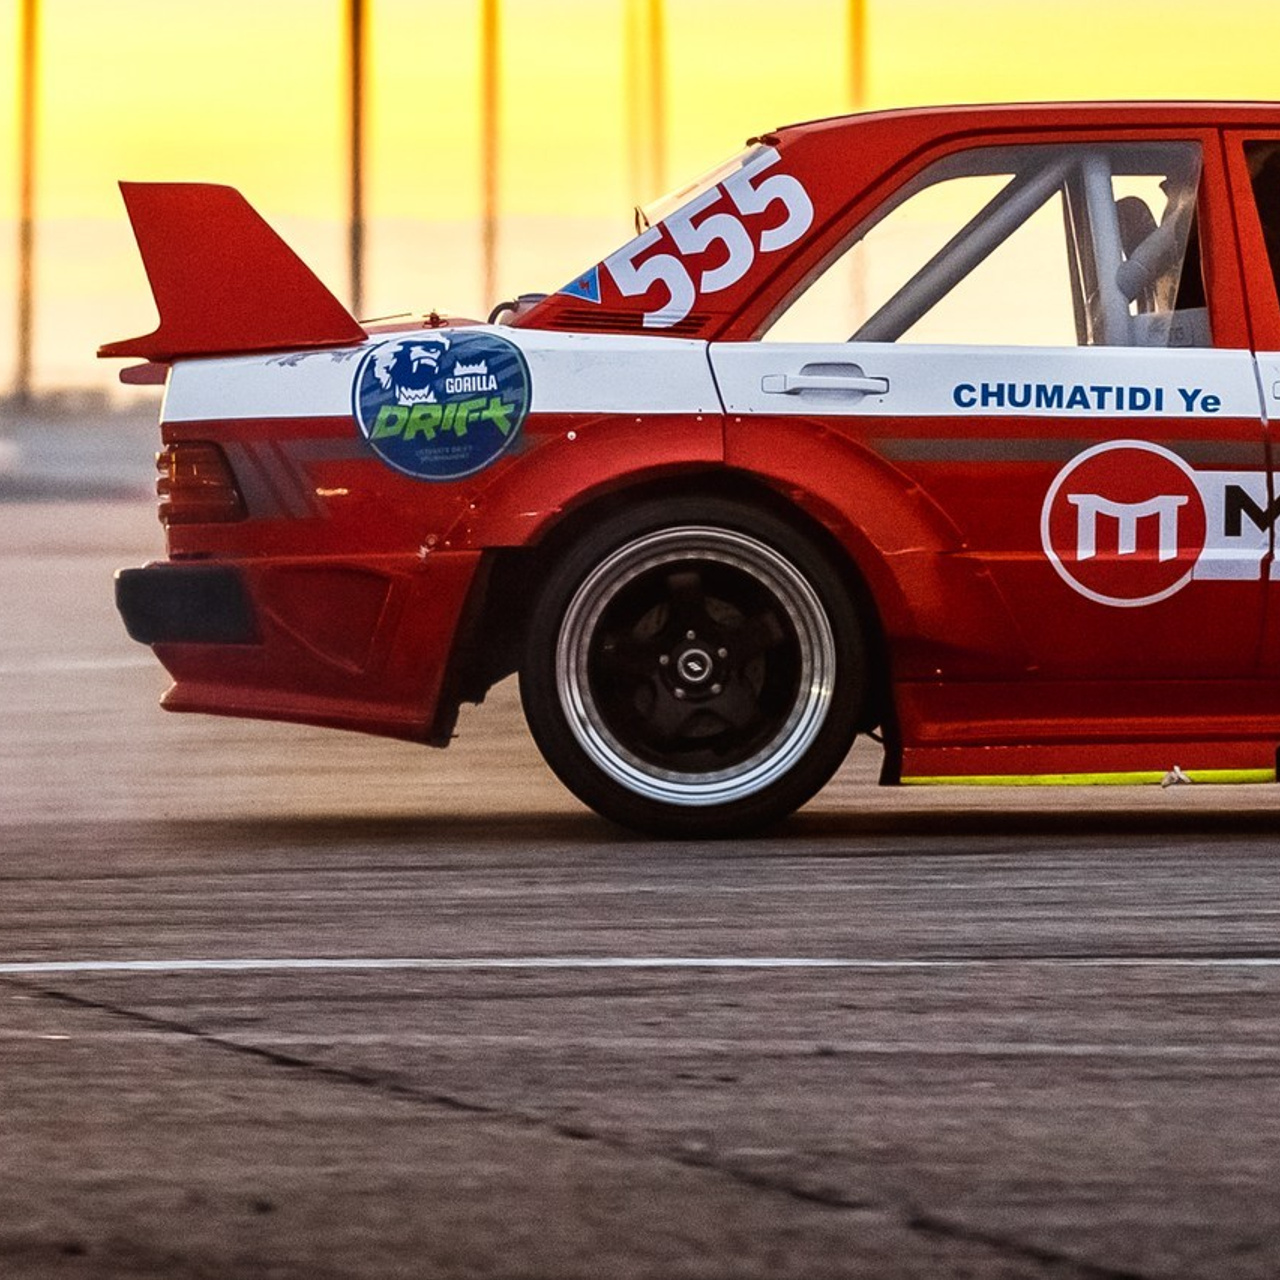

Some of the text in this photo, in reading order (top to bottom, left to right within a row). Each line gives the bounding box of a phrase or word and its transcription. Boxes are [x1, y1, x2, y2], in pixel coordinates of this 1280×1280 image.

[602, 146, 815, 329] 555
[445, 374, 498, 394] GORILLA
[952, 382, 1222, 413] CHUMATIDI Ye
[370, 397, 516, 441] DRIFT
